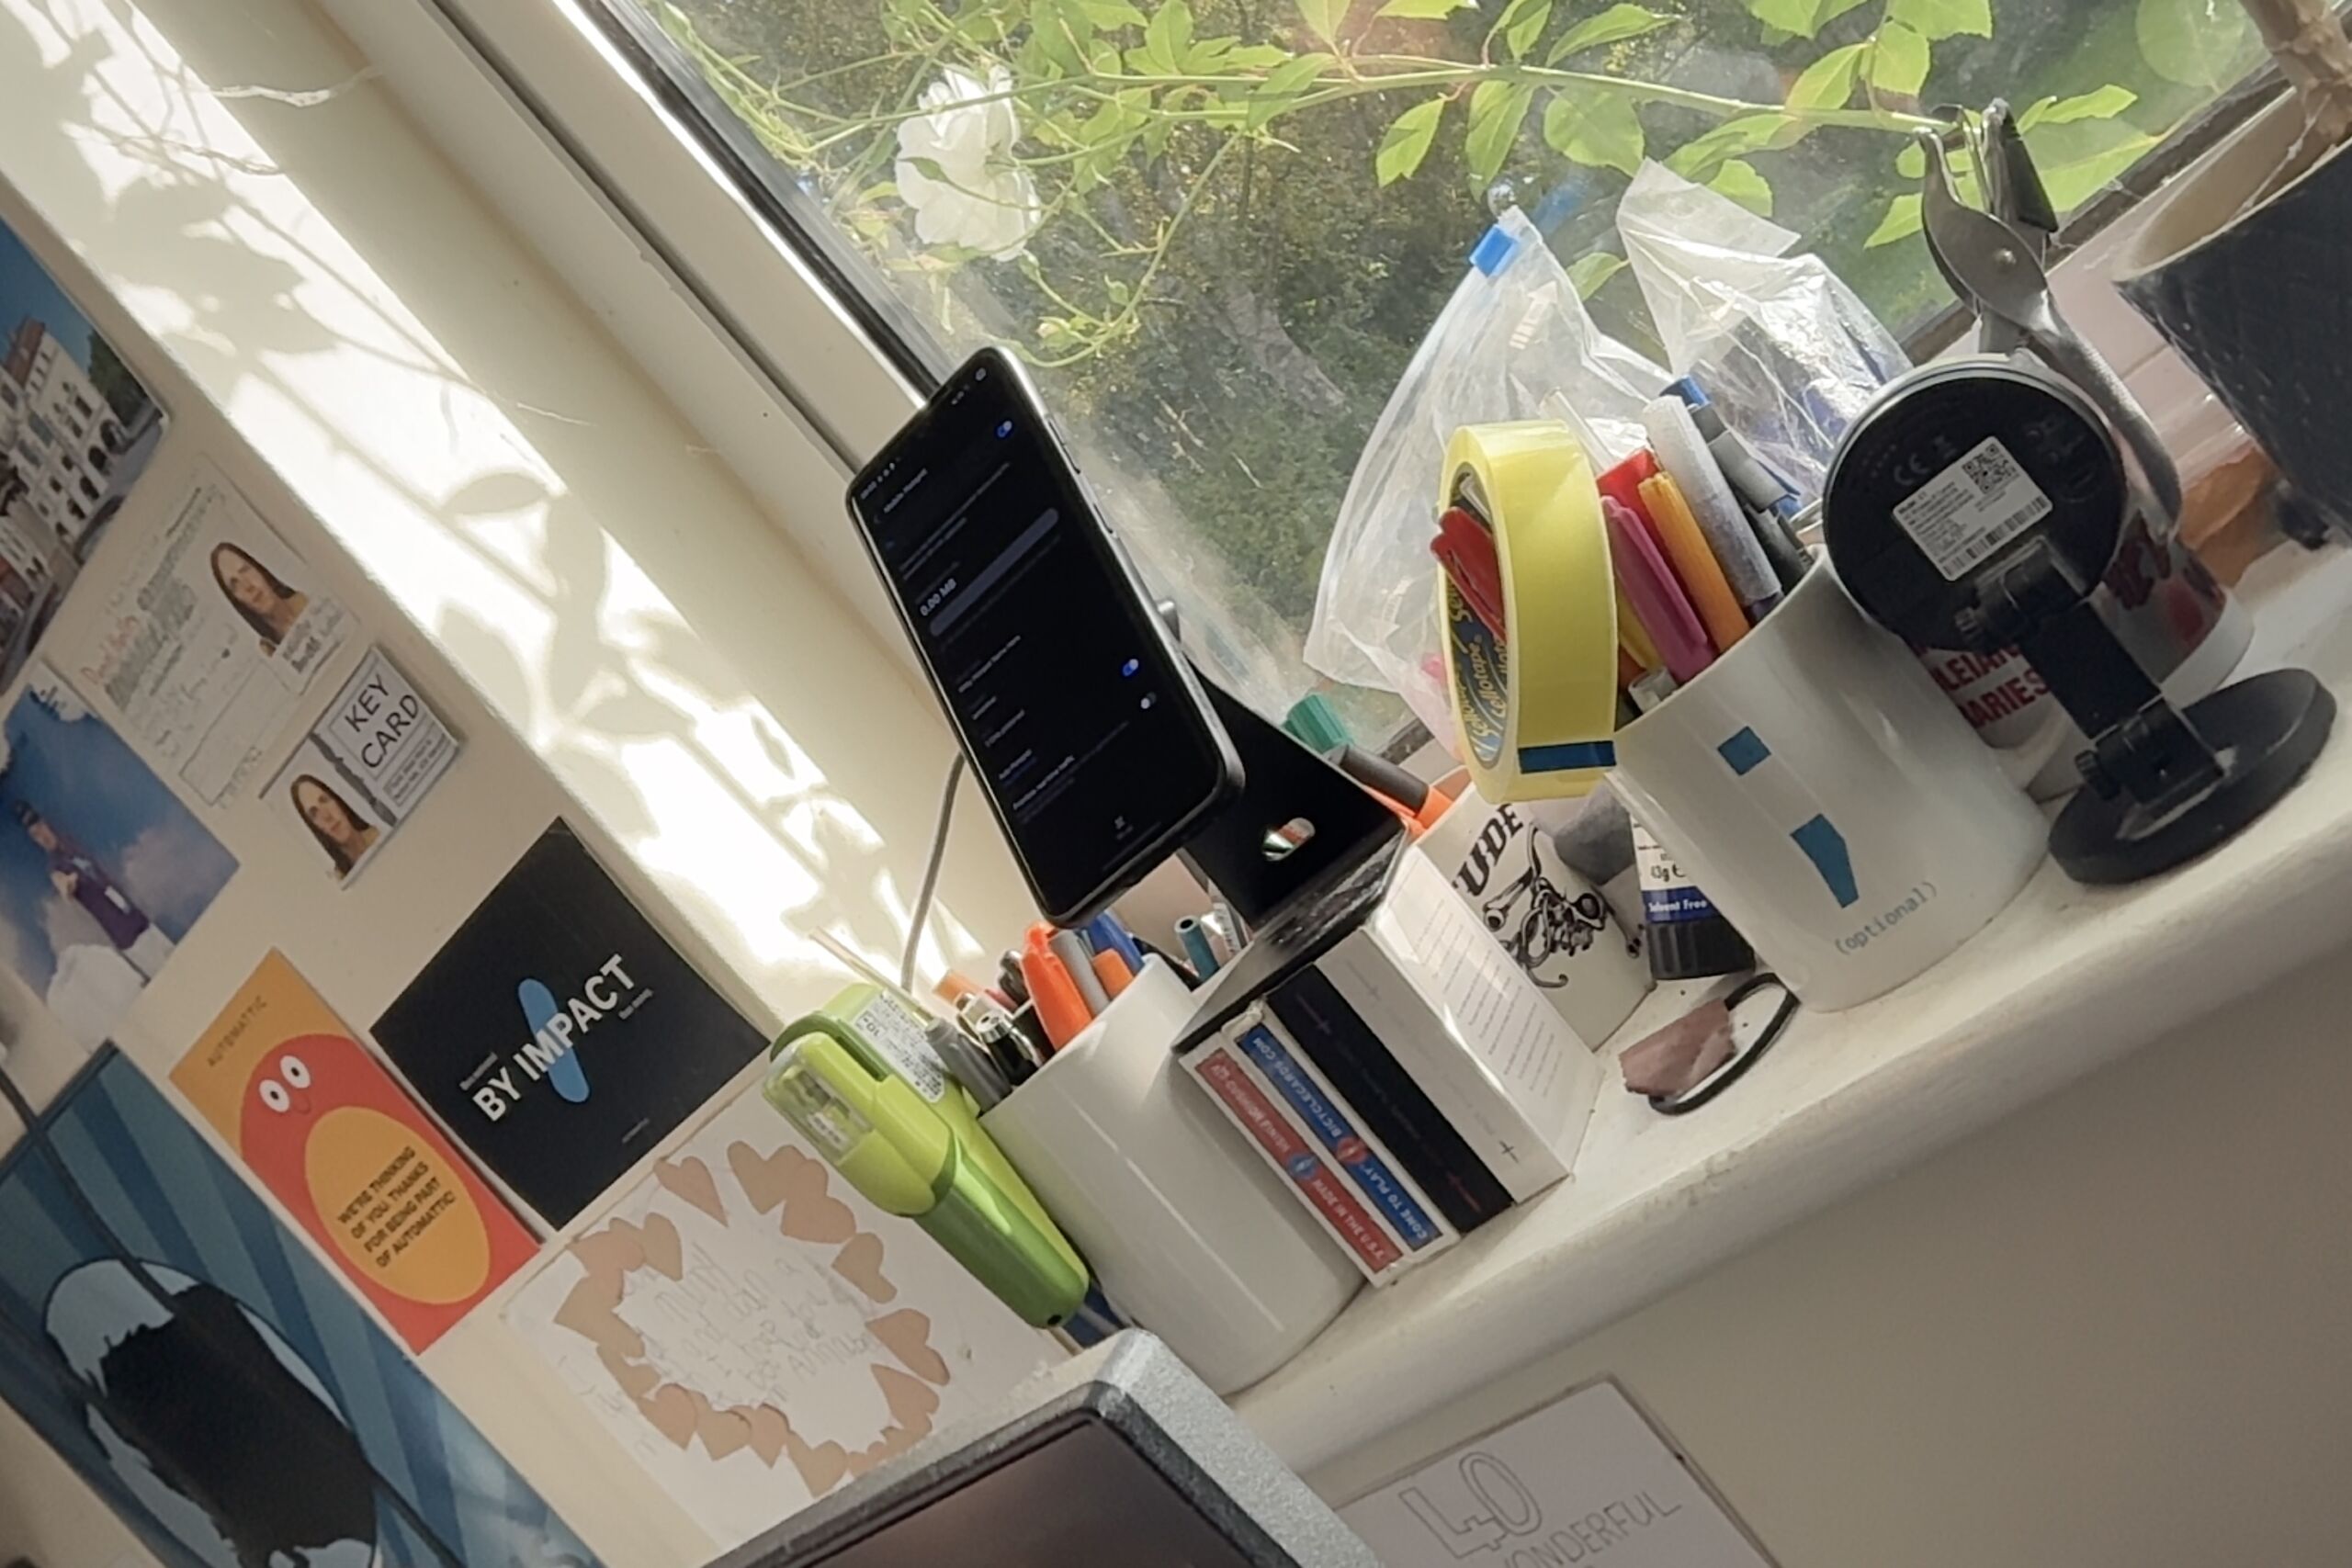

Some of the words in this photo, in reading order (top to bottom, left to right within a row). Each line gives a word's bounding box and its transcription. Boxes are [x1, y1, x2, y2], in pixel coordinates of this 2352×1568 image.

[921, 593, 941, 615] 0.00
[939, 579, 956, 596] MB
[345, 674, 389, 732] KEY
[361, 694, 419, 768] CARD
[1683, 899, 1707, 909] Free
[1835, 882, 1936, 953] (optional)
[473, 1066, 520, 1121] BY
[514, 954, 634, 1080] IMPACT
[369, 1146, 415, 1192] THINKING
[351, 1221, 366, 1239] OF
[388, 1161, 428, 1201] THANKS
[364, 1229, 388, 1253] FOR
[385, 1201, 417, 1233] BEING
[414, 1177, 439, 1203] PART
[1312, 1179, 1338, 1205] MADE
[1335, 1205, 1347, 1216] IN
[1345, 1215, 1364, 1235] THE
[1388, 1194, 1402, 1210] TO
[1400, 1209, 1428, 1240] COME
[376, 1249, 390, 1267] OF
[1501, 1491, 1682, 1565] ONDERFUL
